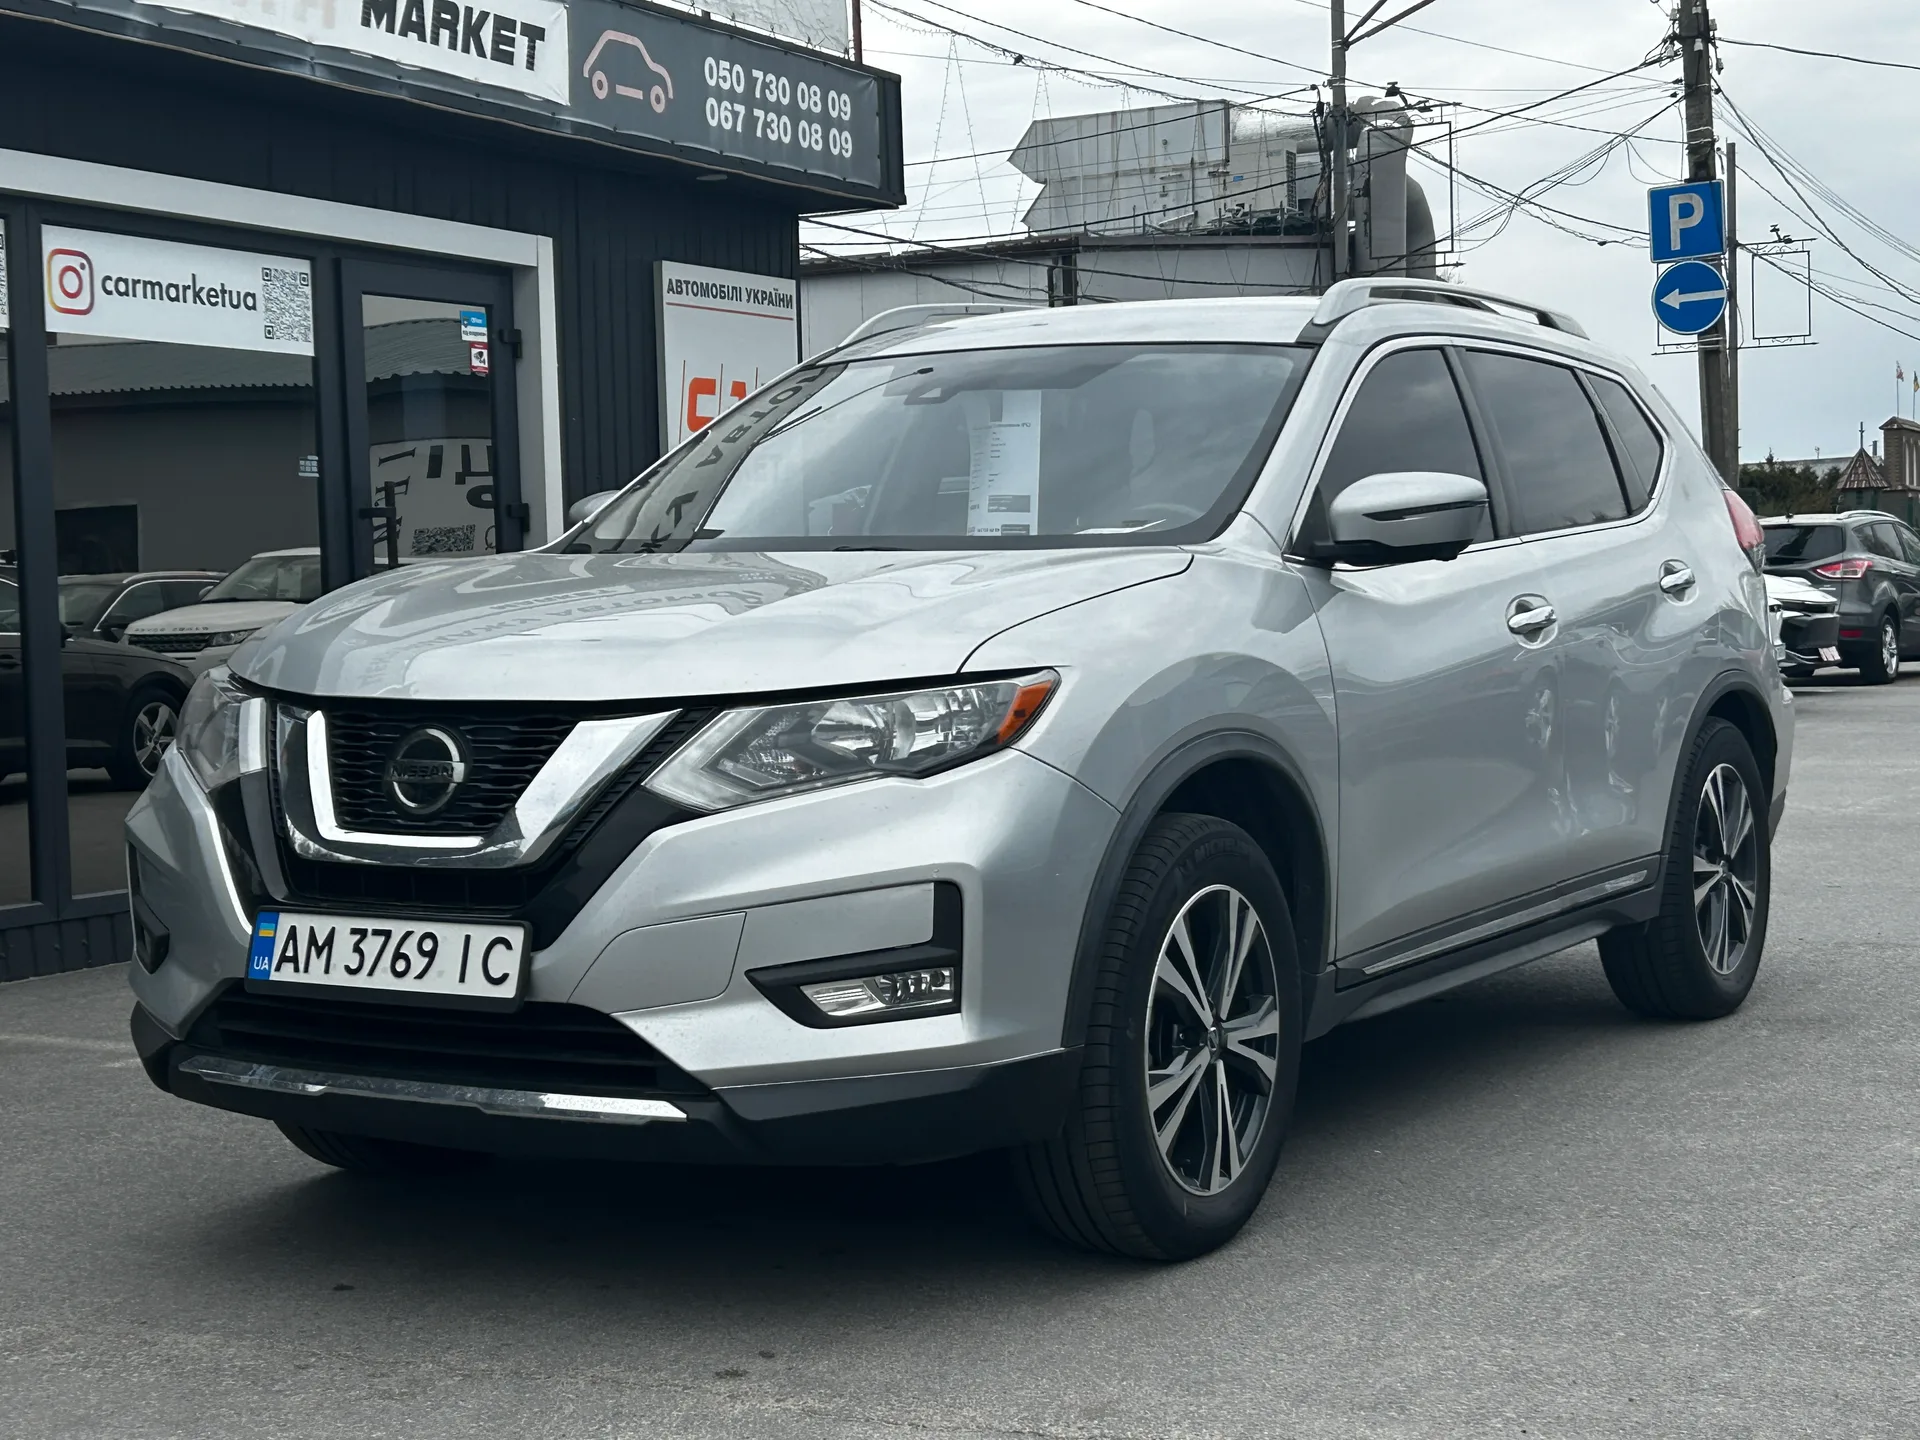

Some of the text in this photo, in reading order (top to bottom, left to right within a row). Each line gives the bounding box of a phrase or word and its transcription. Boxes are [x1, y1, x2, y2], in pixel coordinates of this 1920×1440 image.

[361, 0, 546, 72] MARKET
[704, 56, 851, 121] 050 730 08 09
[705, 97, 852, 158] 067 730 08 09
[1668, 192, 1704, 251] P
[101, 273, 257, 311] carmarketua
[666, 278, 794, 310] АВТОМОБІЛІ УКРАЇНИ
[253, 955, 270, 972] UA
[274, 924, 514, 986] AM 3769 IC
